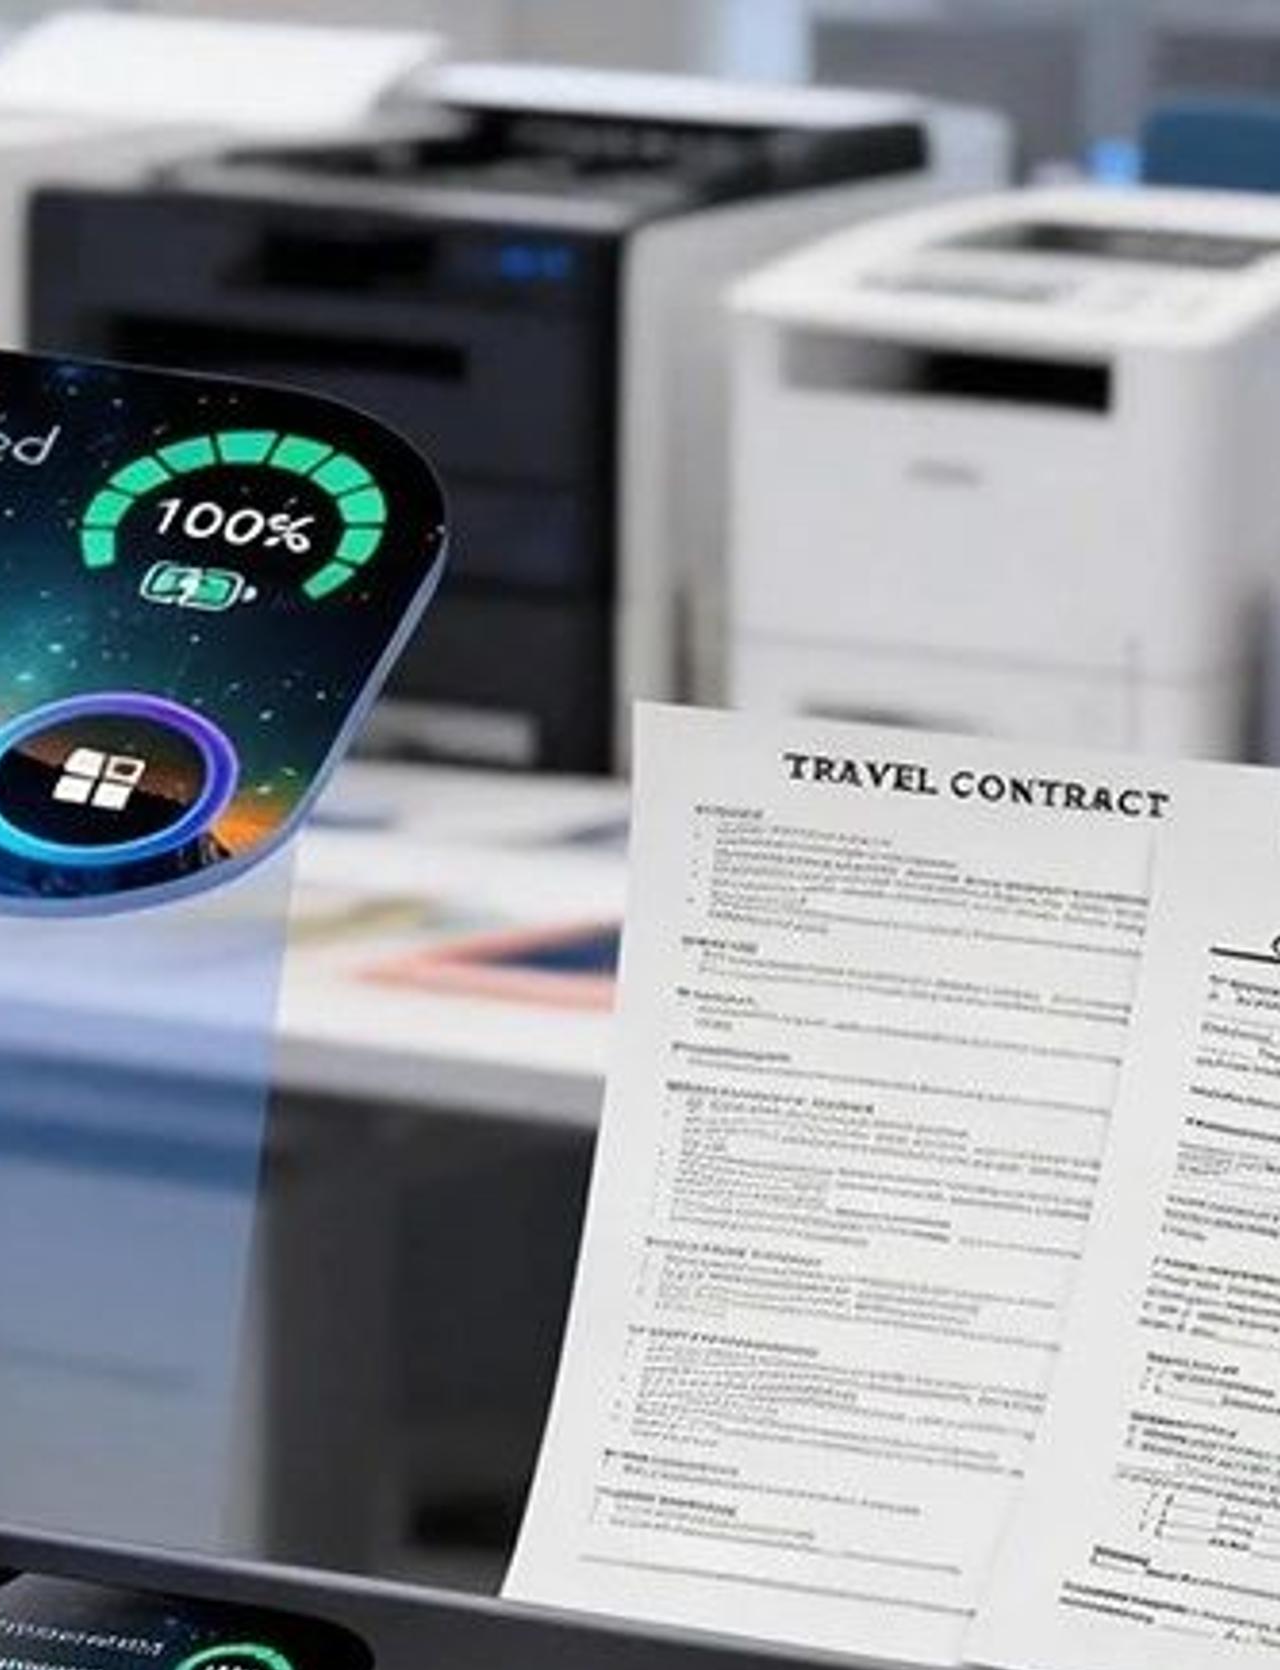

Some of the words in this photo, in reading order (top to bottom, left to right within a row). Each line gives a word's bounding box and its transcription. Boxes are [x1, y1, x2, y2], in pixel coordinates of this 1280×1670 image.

[157, 497, 315, 554] 100%
[782, 751, 940, 797] TRAVEL
[949, 769, 1172, 819] CONTRACT
